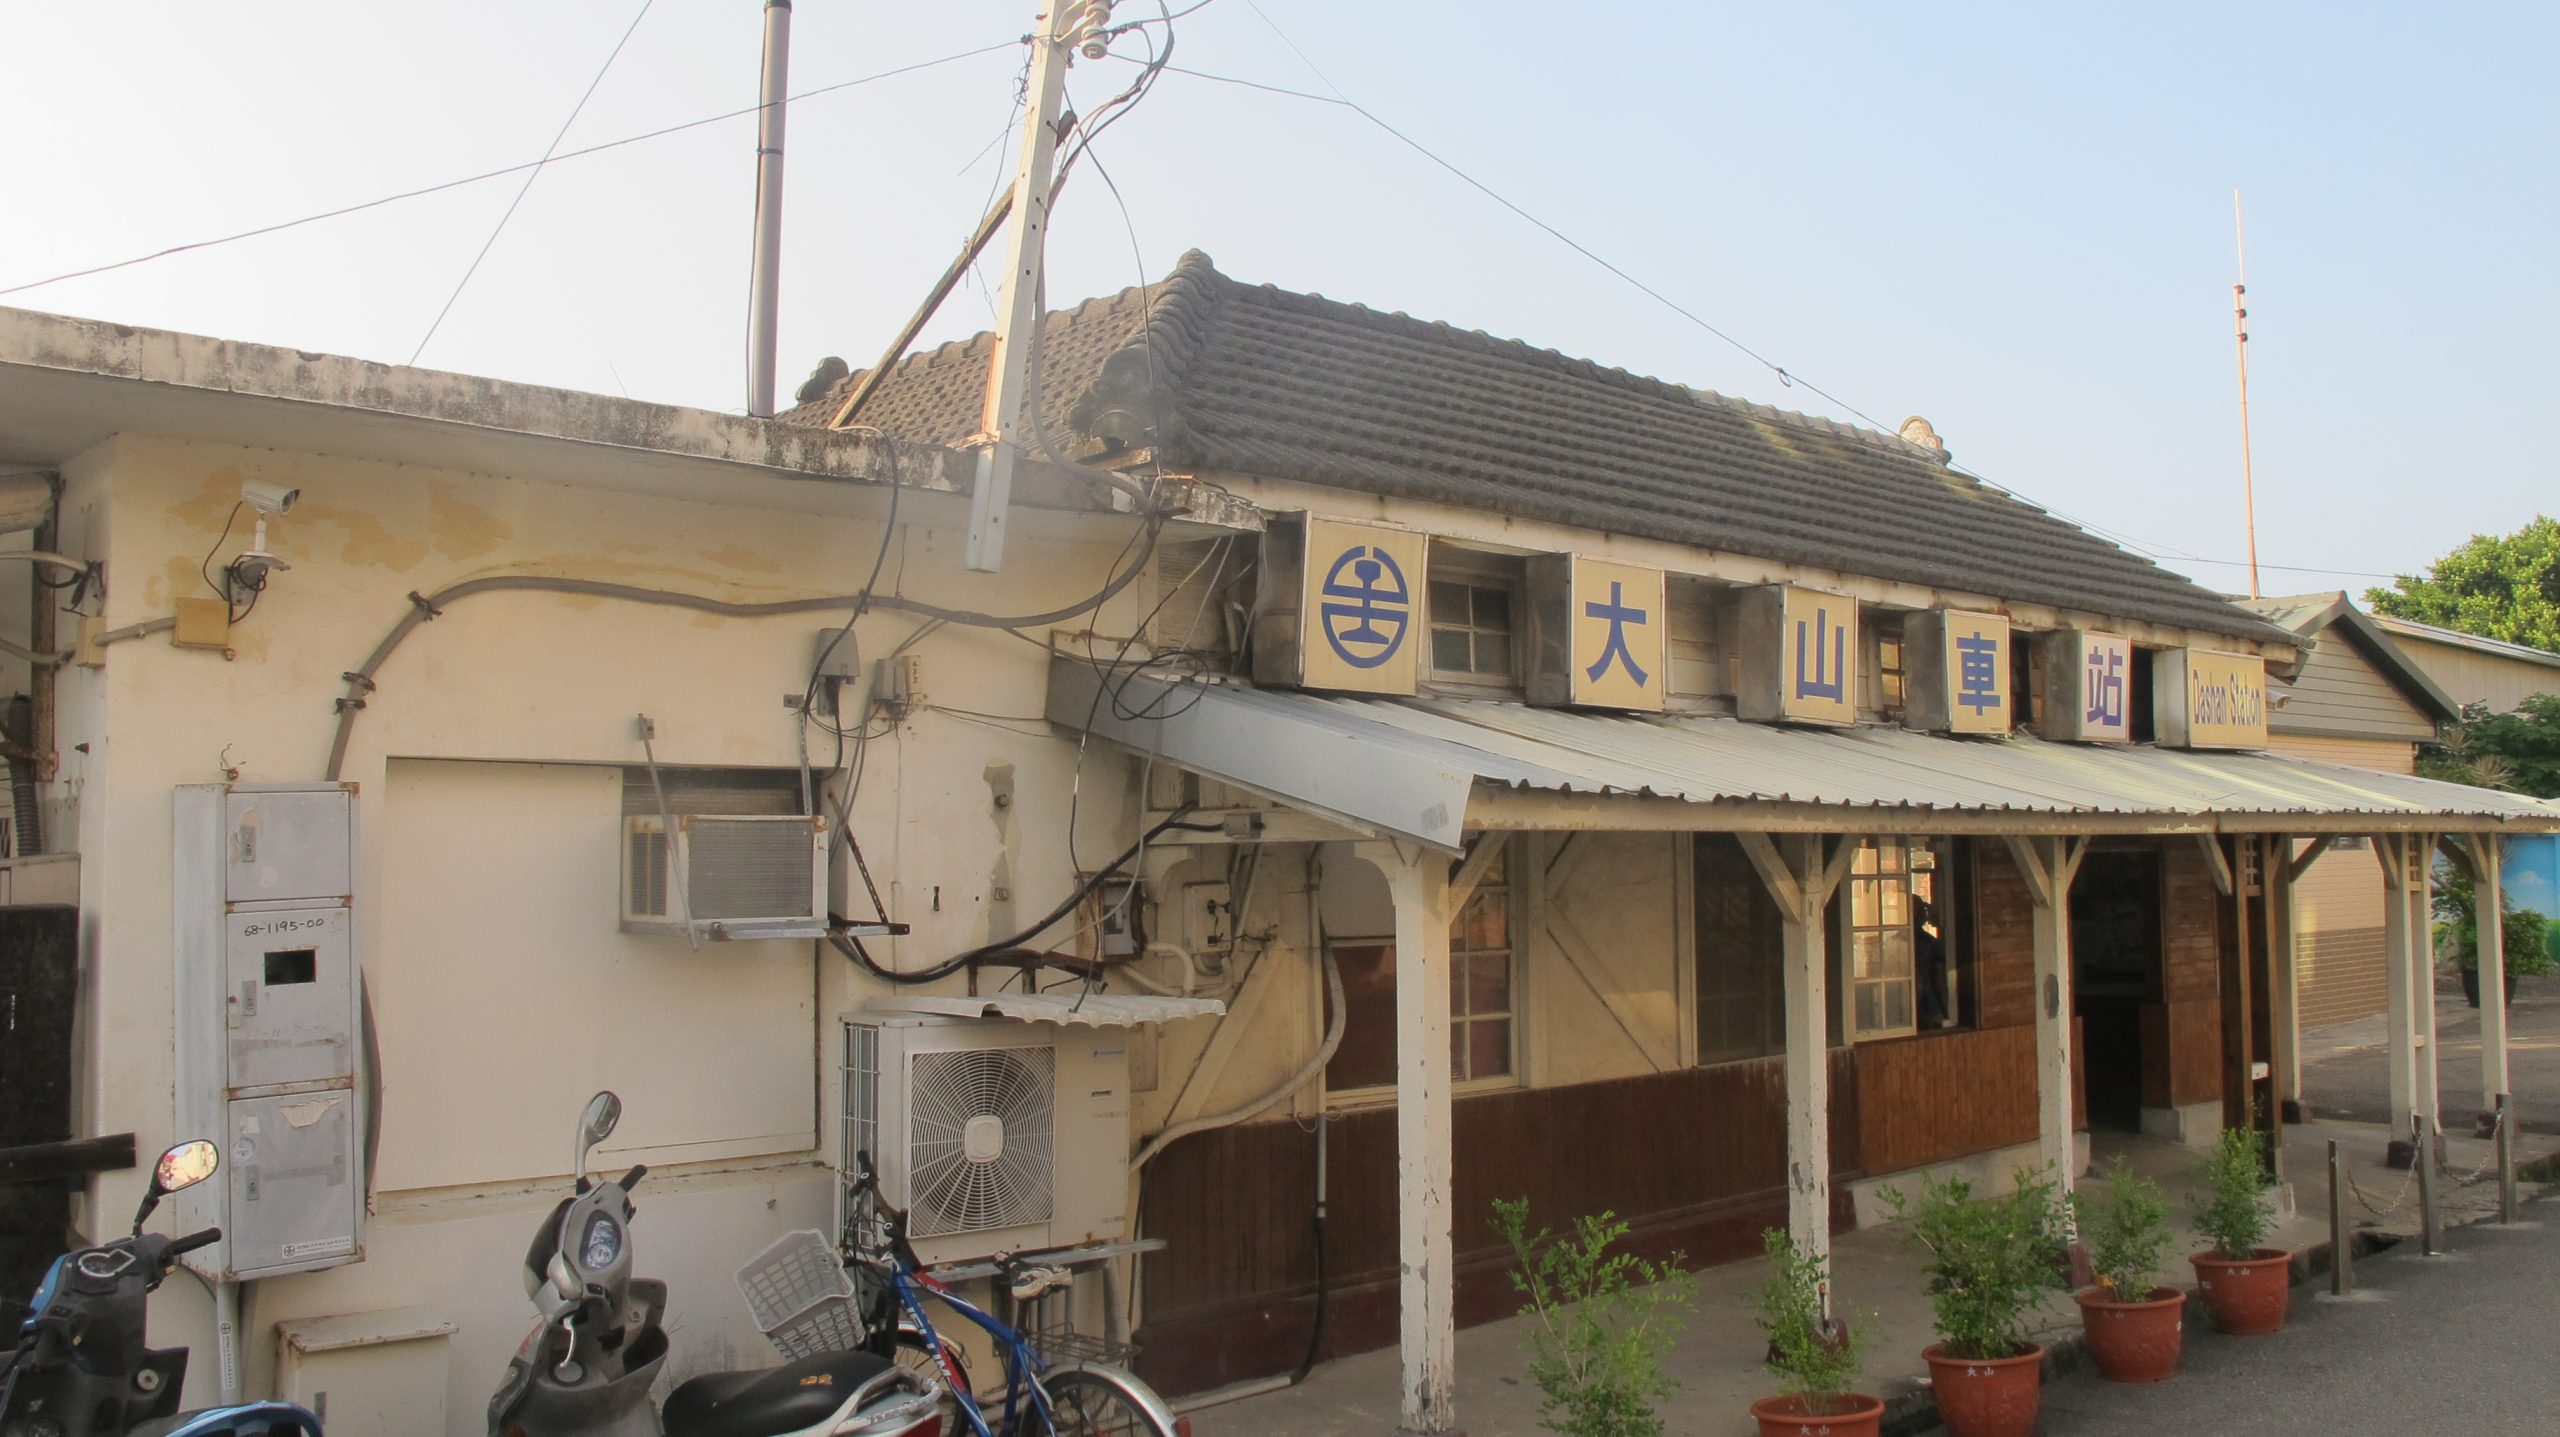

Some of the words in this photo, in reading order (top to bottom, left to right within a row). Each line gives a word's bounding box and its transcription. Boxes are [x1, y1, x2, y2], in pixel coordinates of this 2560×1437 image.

[2192, 669, 2226, 725] Dashan
[2230, 672, 2261, 727] Station
[244, 918, 324, 936] 68-1195-00
